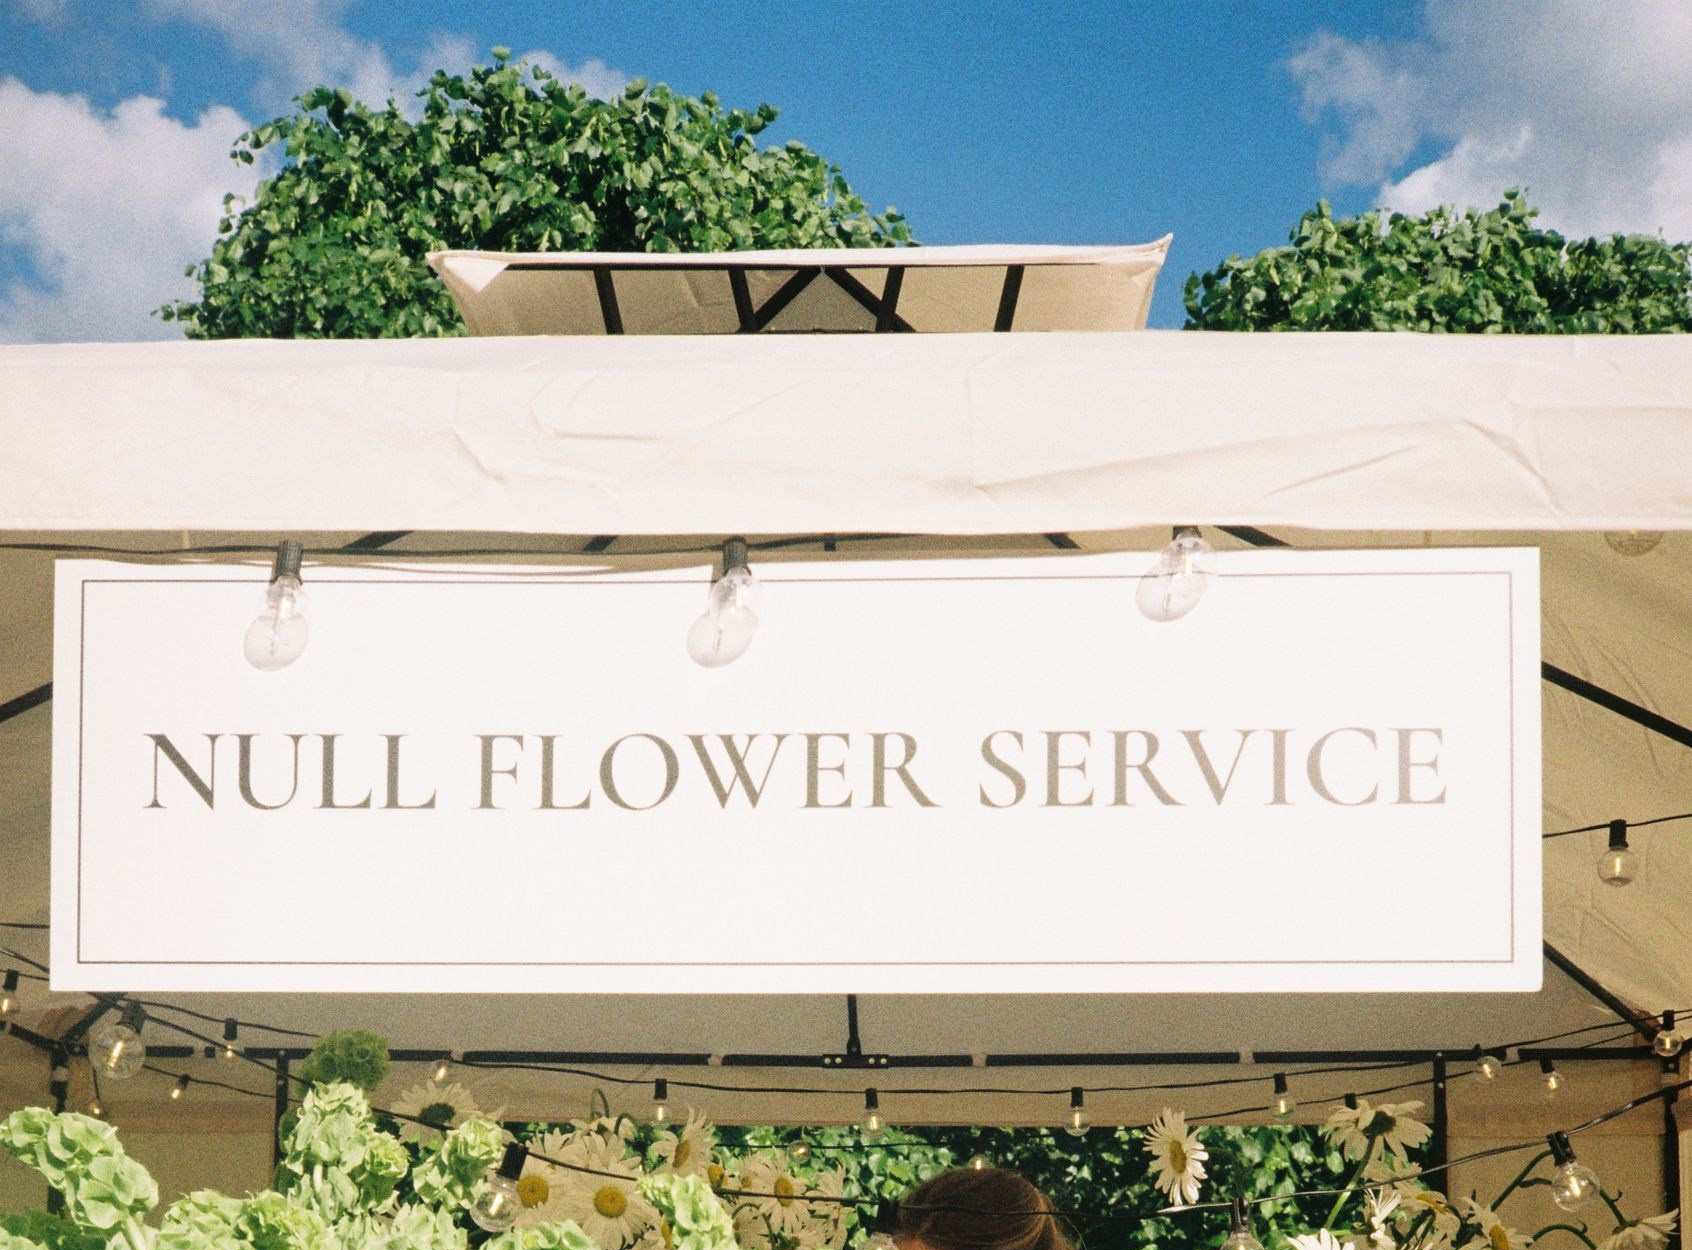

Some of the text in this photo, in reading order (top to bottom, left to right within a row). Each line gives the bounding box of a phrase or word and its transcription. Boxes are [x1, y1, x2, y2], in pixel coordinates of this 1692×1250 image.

[143, 727, 1447, 811] NULL FLOWER SERVICE
